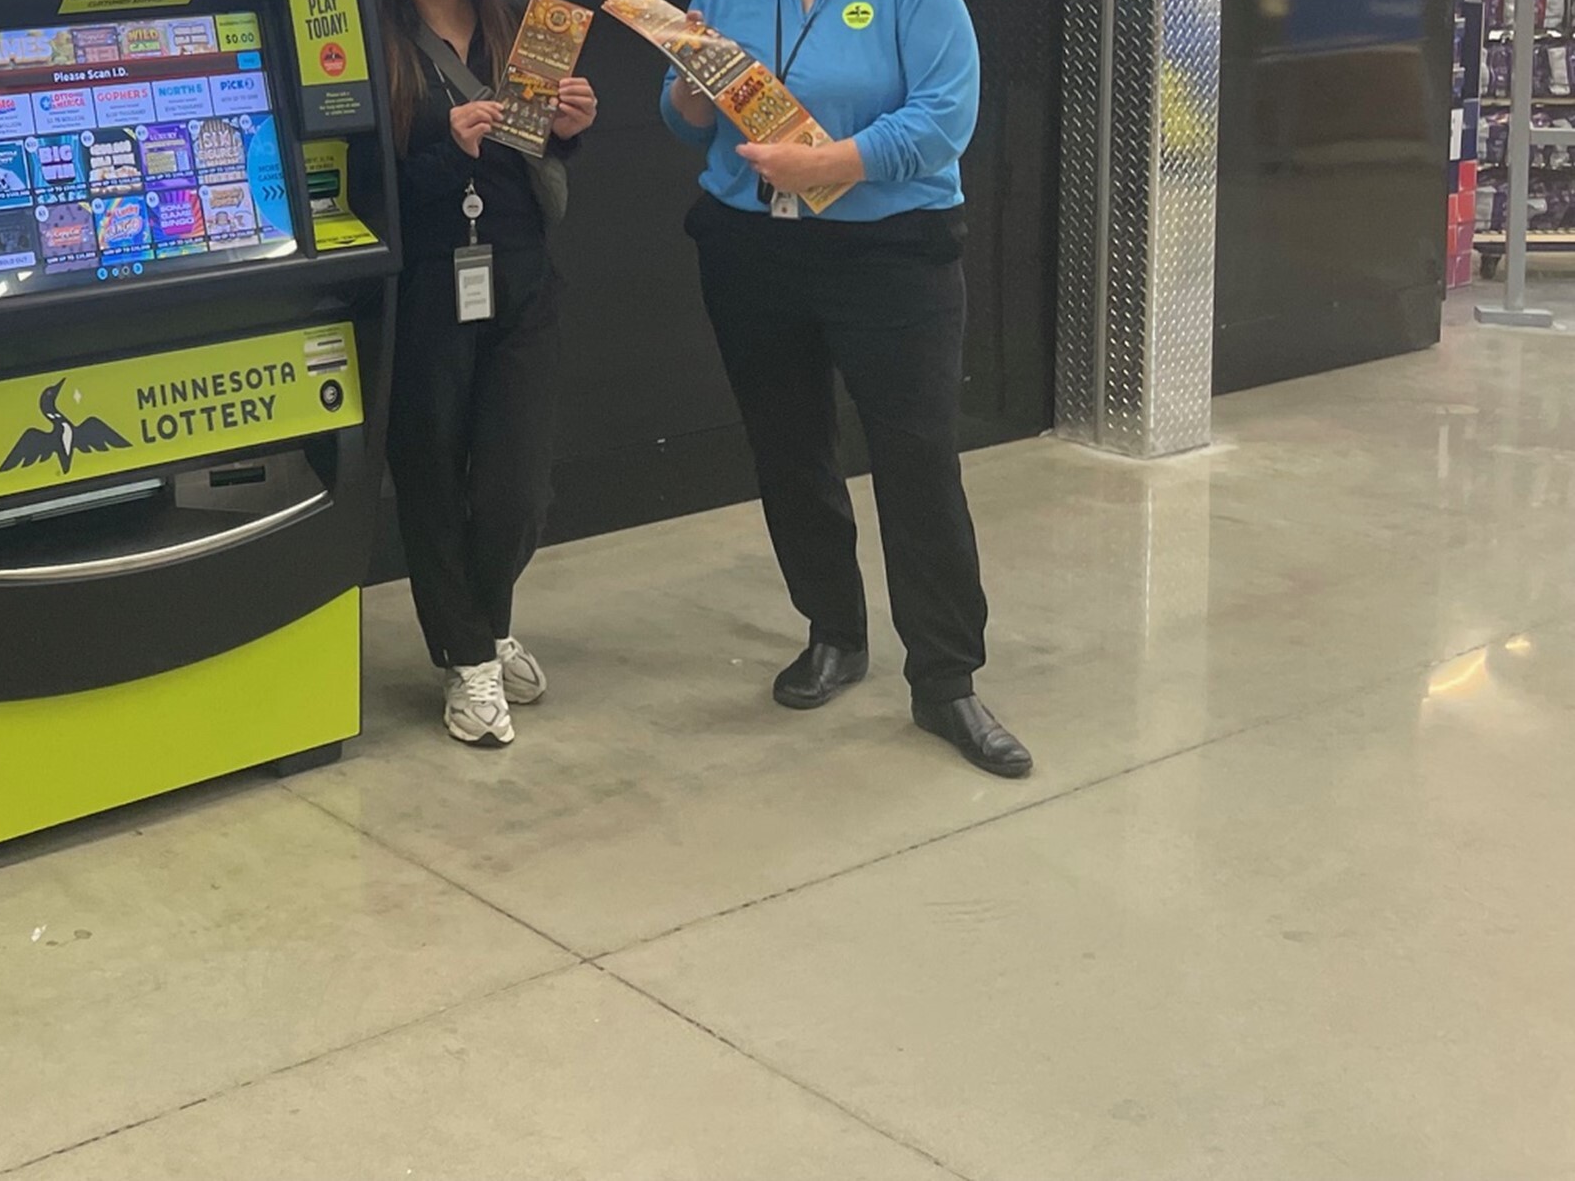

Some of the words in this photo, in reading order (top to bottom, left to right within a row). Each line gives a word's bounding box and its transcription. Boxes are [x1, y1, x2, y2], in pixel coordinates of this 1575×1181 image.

[305, 12, 349, 41] TODAY!
[225, 32, 255, 44] $0.00
[53, 72, 85, 83] Please
[87, 68, 111, 80] Scan
[113, 67, 129, 77] I.D.
[97, 89, 139, 102] GOPHER
[158, 85, 194, 97] NORTH
[38, 144, 73, 164] BIG
[136, 361, 297, 410] MINNESOTA
[140, 394, 278, 444] LOTTERY
